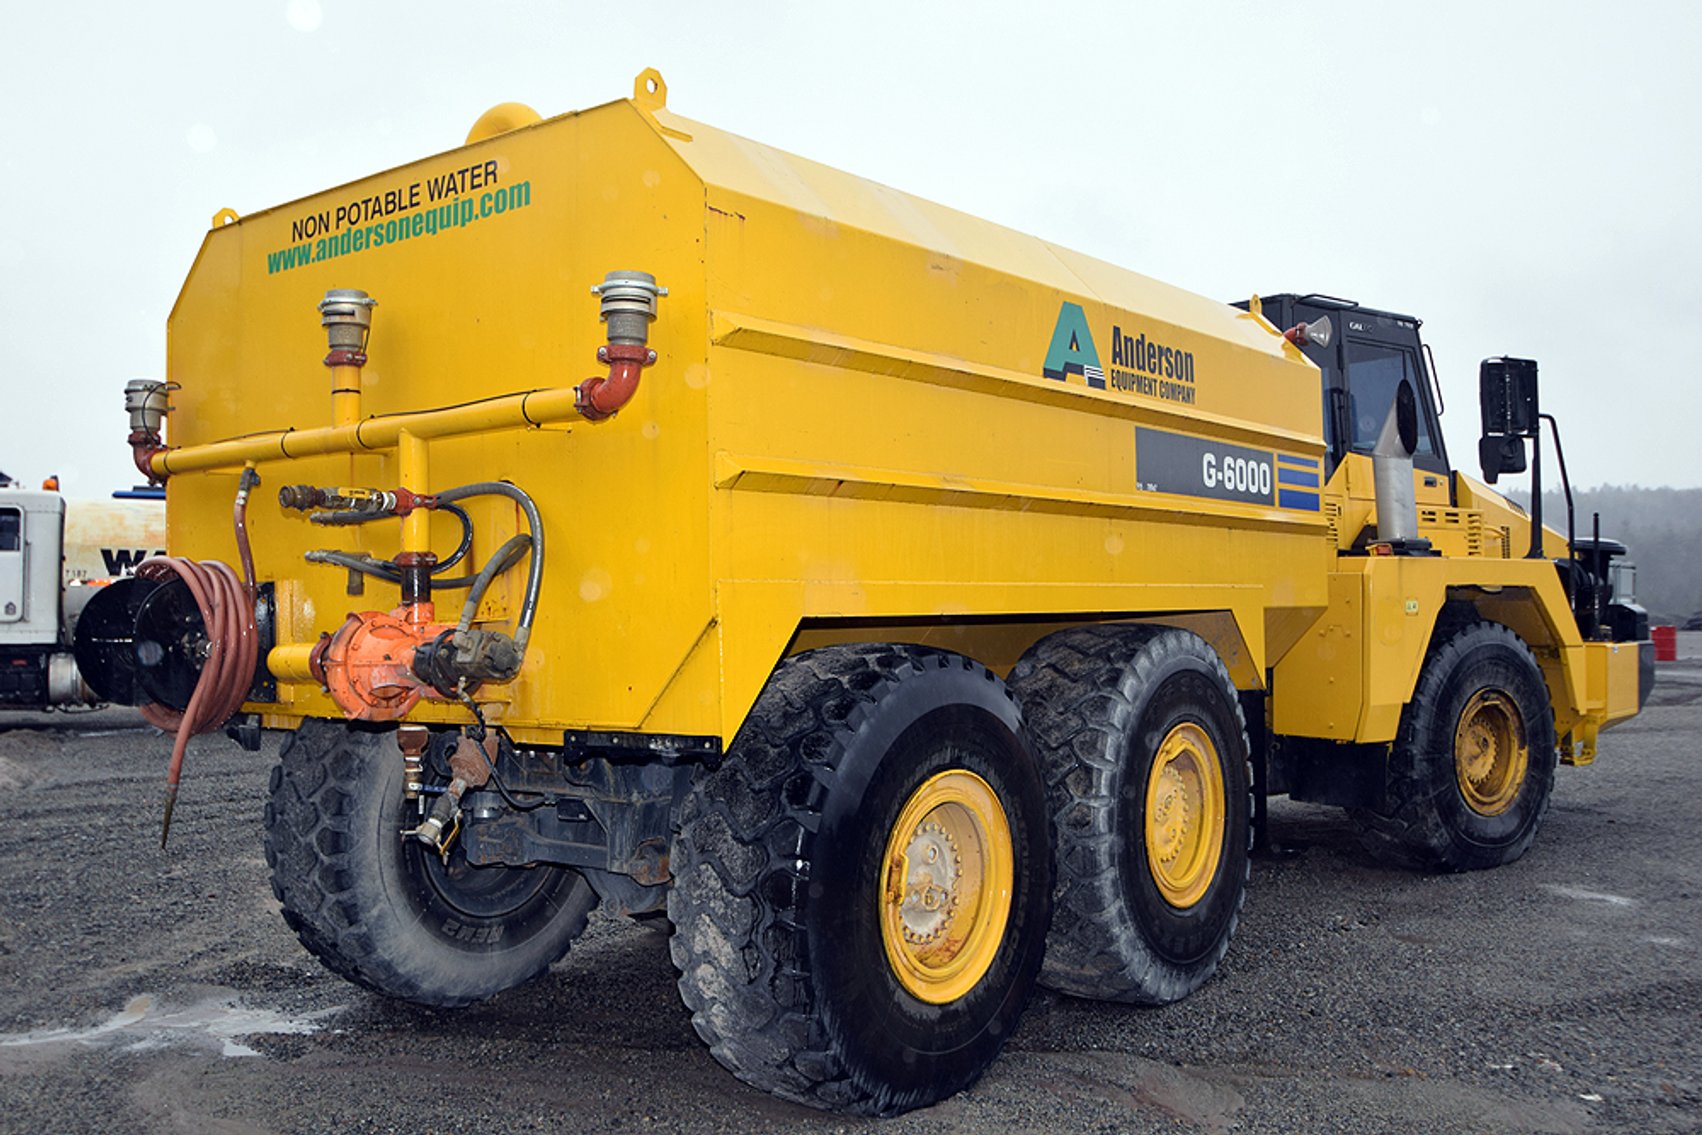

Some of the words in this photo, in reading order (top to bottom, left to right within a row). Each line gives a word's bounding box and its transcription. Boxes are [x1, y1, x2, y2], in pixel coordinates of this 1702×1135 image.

[266, 180, 531, 275] www.andersonequip.com
[291, 211, 330, 242] NON
[335, 183, 421, 230] POTABLE
[427, 159, 498, 202] WATER
[1111, 325, 1195, 384] Anderson
[1111, 368, 1158, 397] EQUIPMENT
[1159, 380, 1196, 406] COMPANY
[1202, 452, 1271, 496] G-6000
